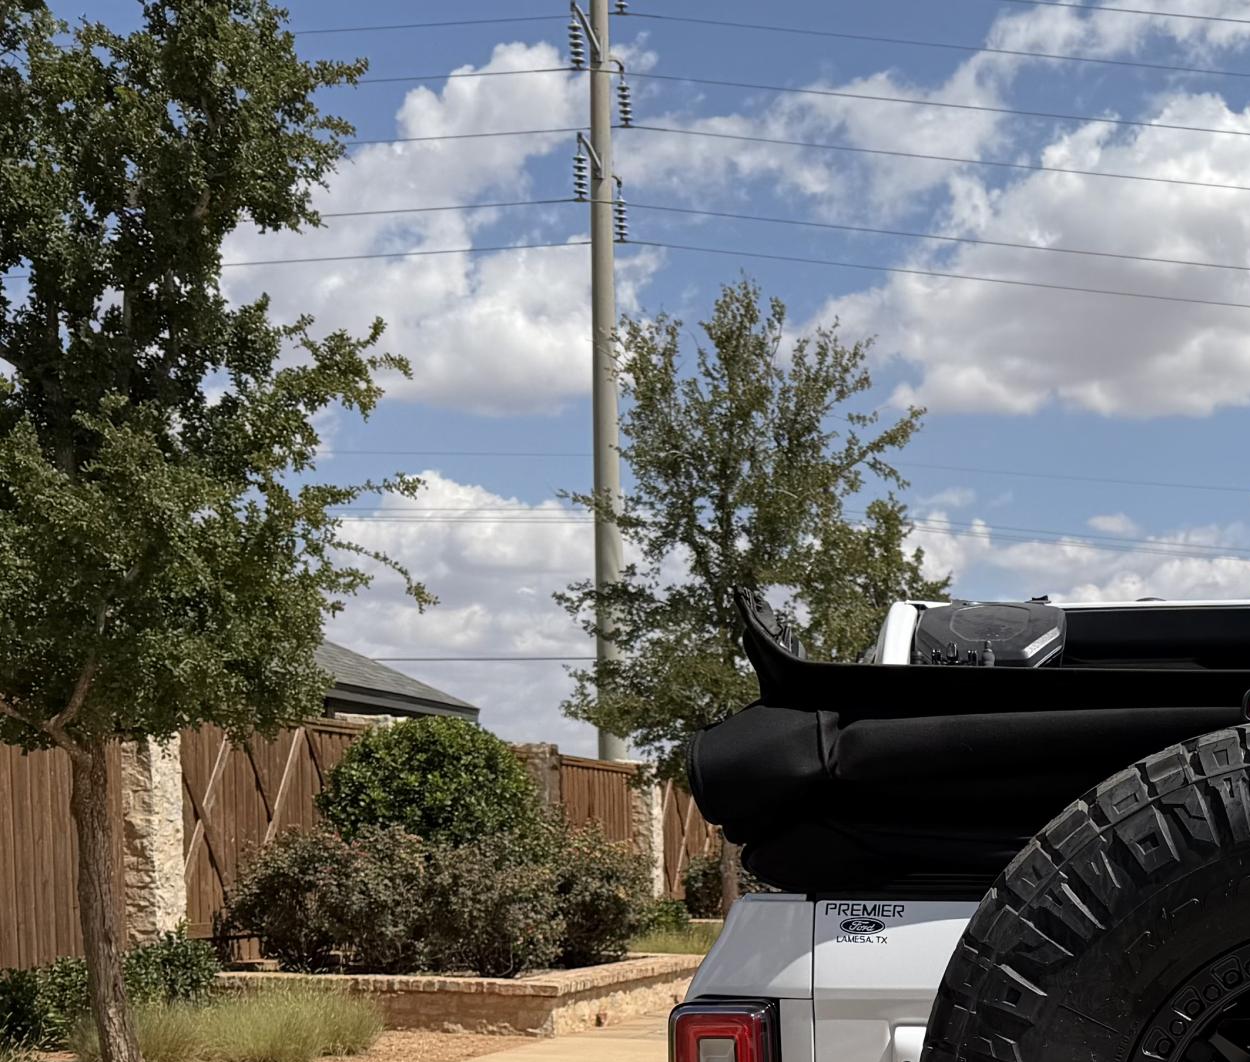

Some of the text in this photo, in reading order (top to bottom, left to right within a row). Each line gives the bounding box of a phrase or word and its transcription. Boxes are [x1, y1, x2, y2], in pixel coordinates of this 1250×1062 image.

[825, 903, 905, 918] PREMIER
[849, 921, 876, 932] Ford
[876, 936, 888, 944] TX
